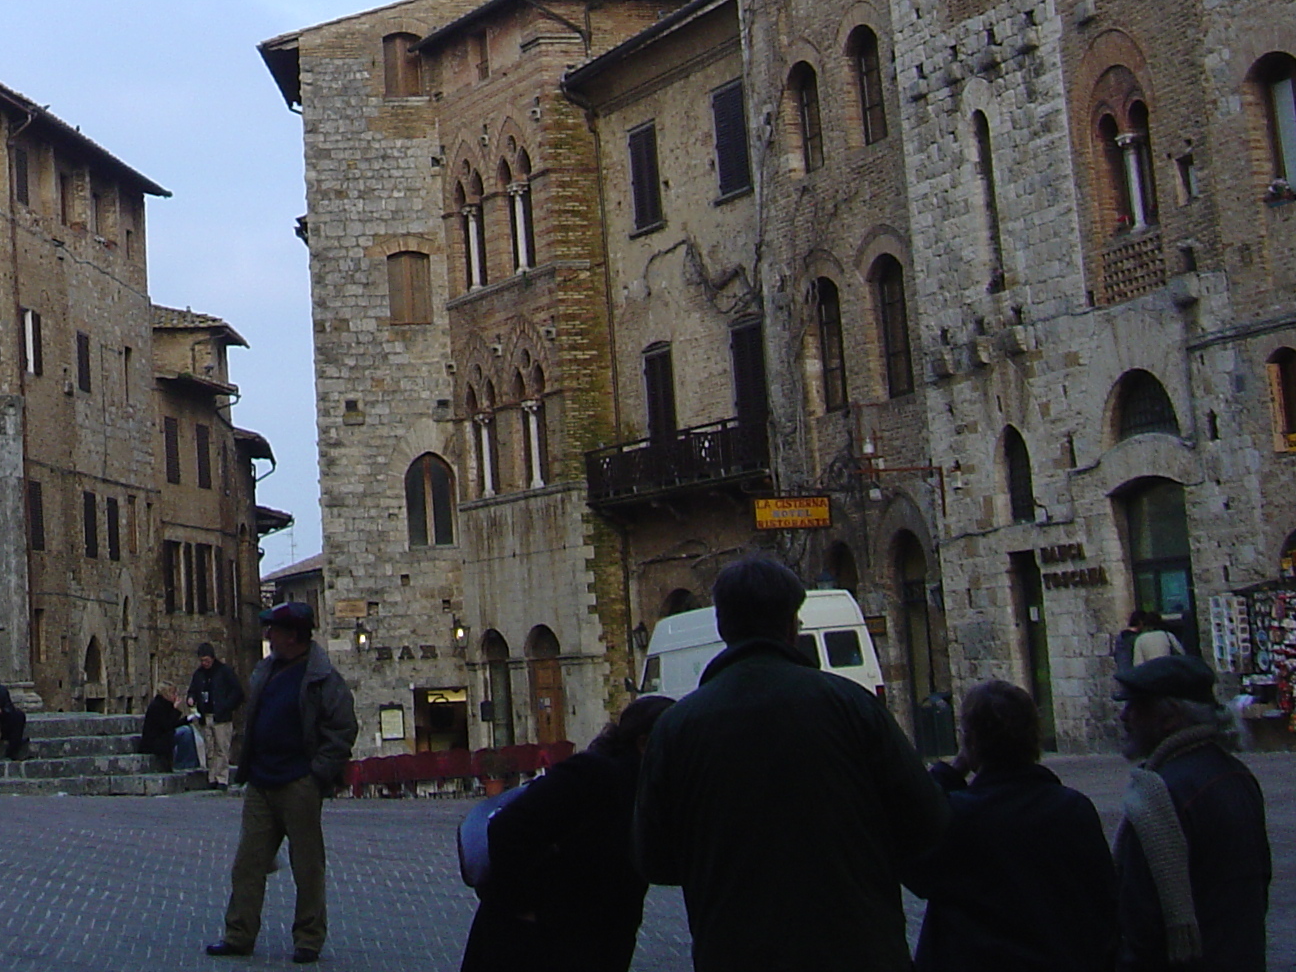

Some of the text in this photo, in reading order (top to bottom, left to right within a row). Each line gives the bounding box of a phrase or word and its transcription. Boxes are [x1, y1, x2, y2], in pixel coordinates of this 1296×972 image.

[755, 498, 827, 510] LA CISTERNA
[773, 509, 811, 518] HOTEL
[756, 518, 830, 529] RISTORANTE
[1040, 542, 1086, 564] BANCA
[1043, 565, 1108, 590] TOSCANA
[375, 645, 438, 660] BAR
